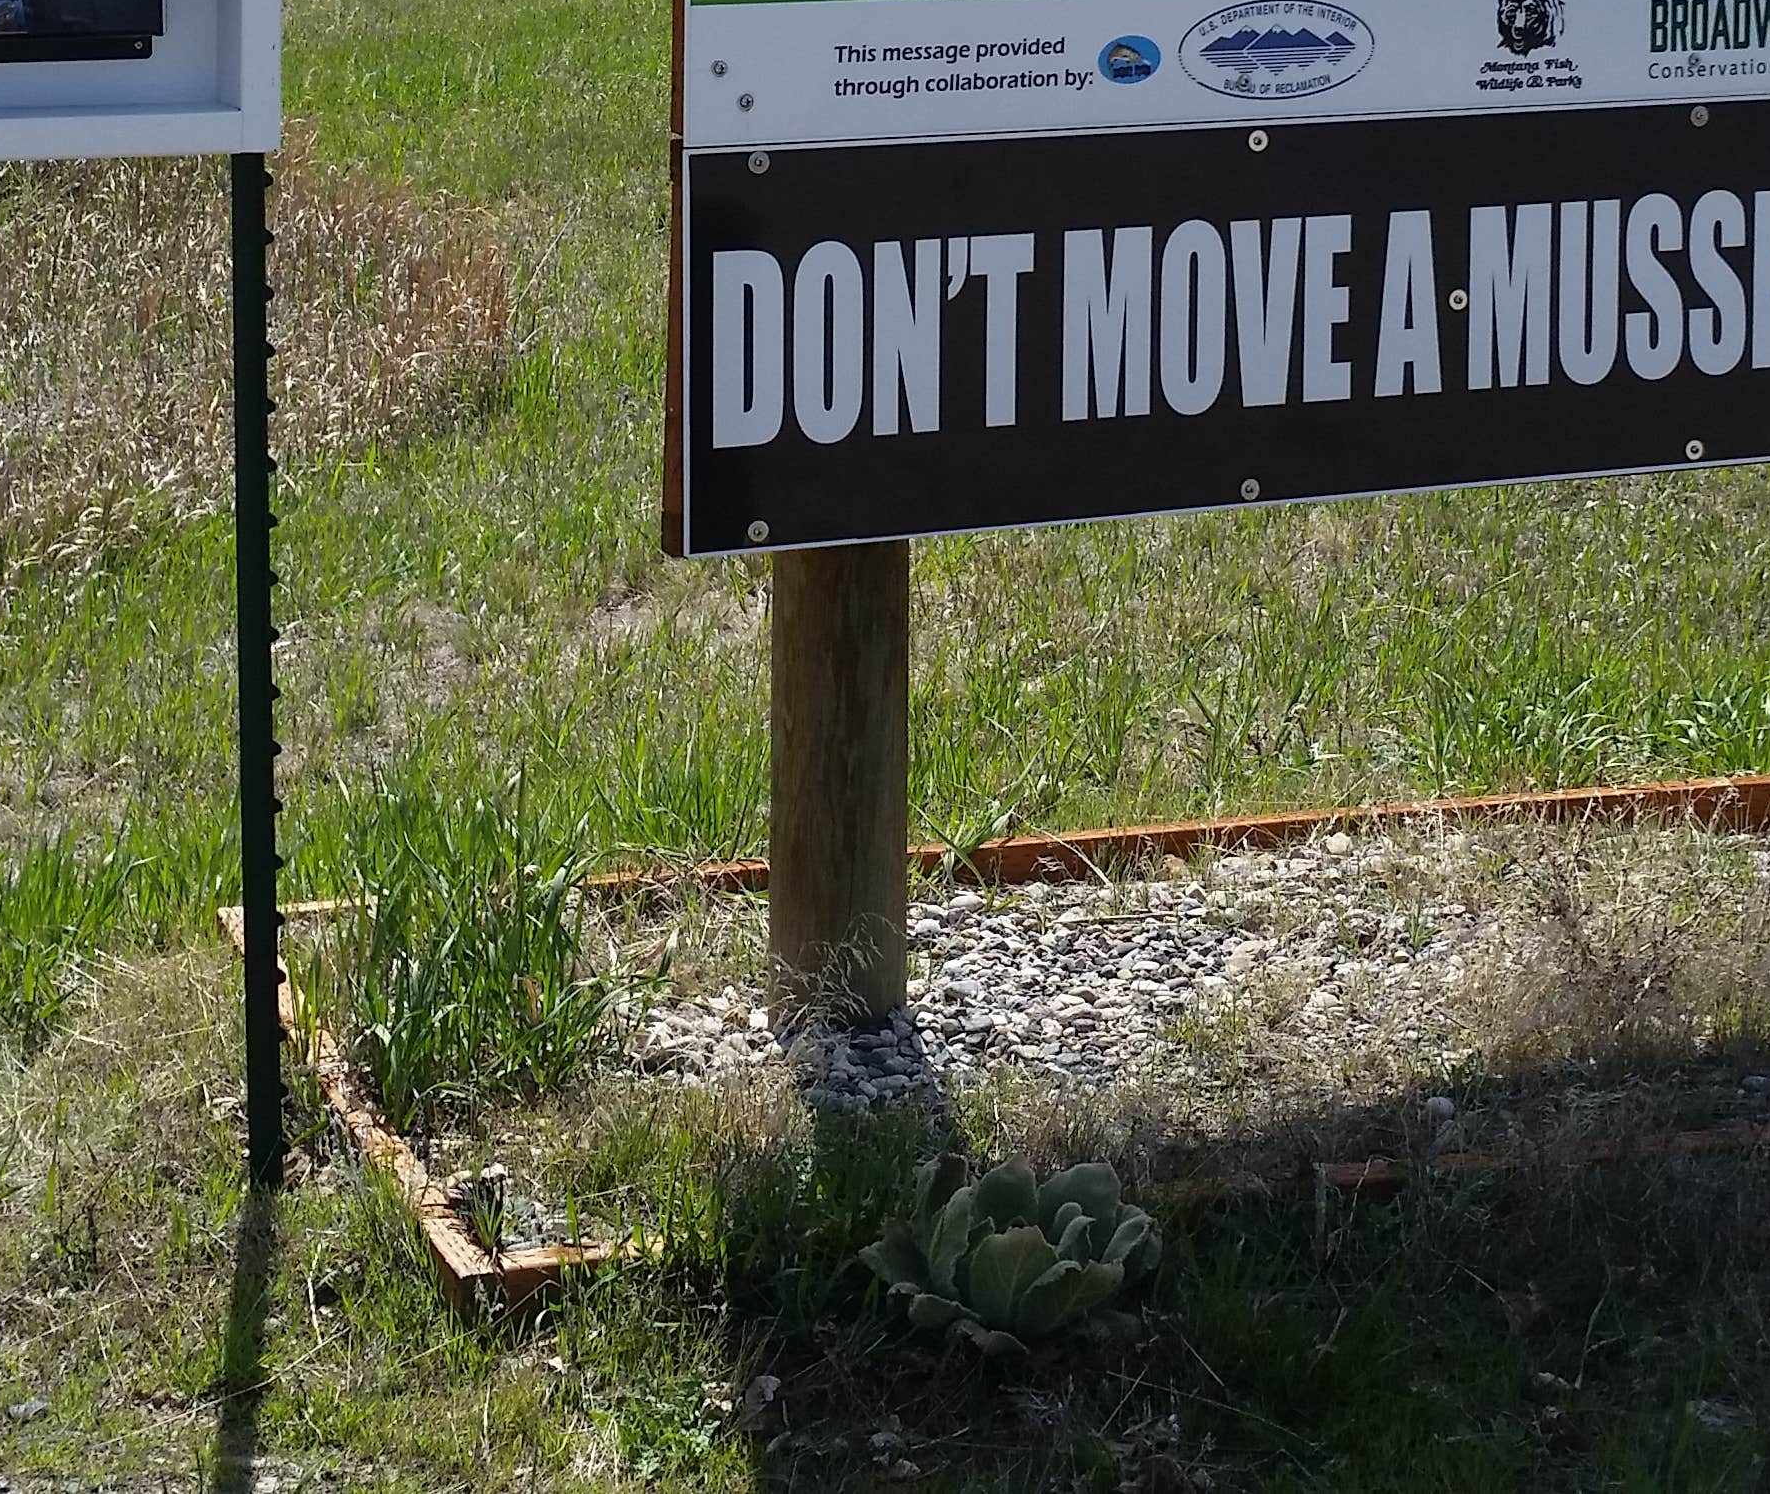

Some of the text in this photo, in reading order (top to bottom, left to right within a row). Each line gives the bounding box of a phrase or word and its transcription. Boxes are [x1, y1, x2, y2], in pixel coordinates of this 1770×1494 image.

[1198, 3, 1358, 37] U.S. DEPARTMENT OF THE INTERIOR
[834, 36, 1066, 64] This message provided
[1479, 60, 1540, 75] Montana
[834, 75, 919, 99] through
[924, 70, 1059, 93] collaboration
[1063, 68, 1094, 91] by:
[1259, 83, 1272, 95] OF
[1275, 73, 1332, 94] RECLAMATION
[1475, 76, 1524, 92] Wildlife
[1545, 74, 1583, 89] Parks
[711, 233, 1036, 451] DON'T
[1061, 214, 1354, 424] MOVE
[1372, 209, 1443, 400] A
